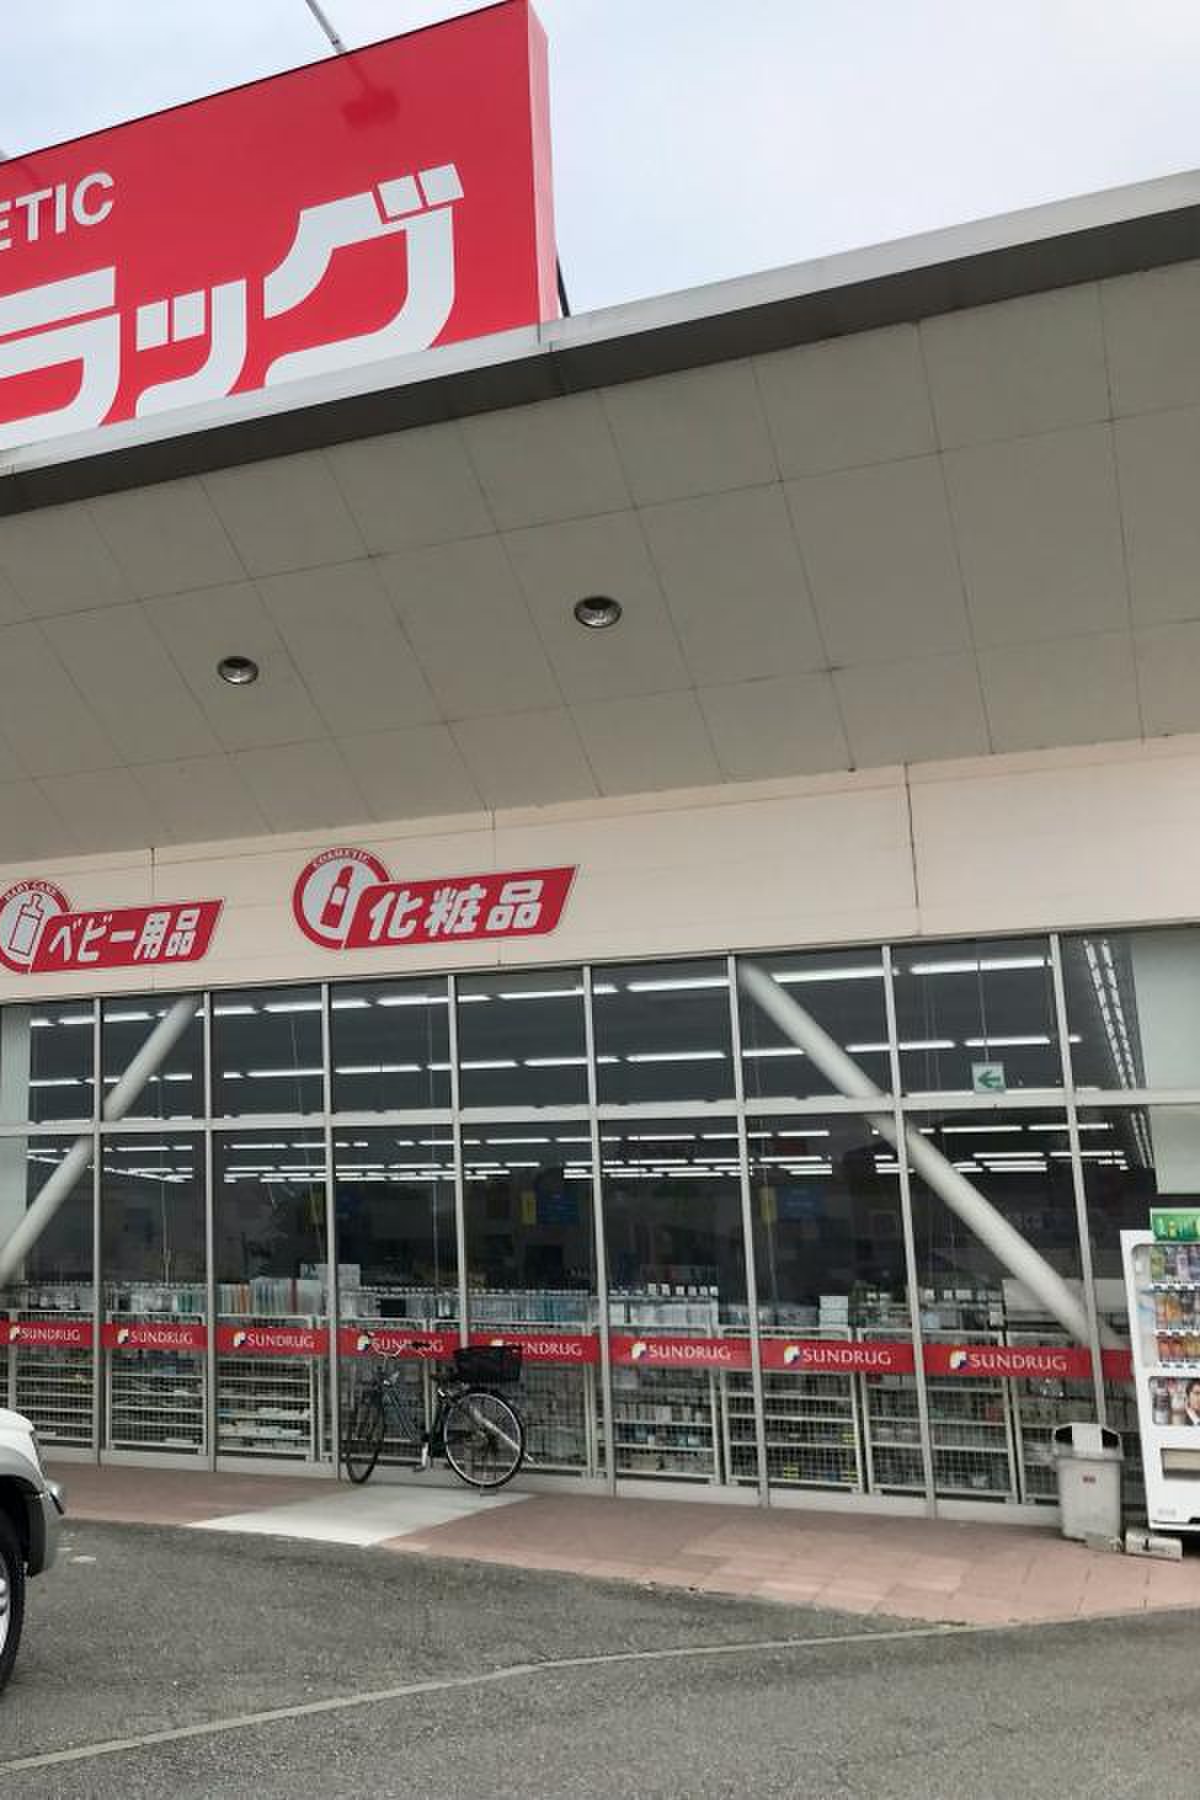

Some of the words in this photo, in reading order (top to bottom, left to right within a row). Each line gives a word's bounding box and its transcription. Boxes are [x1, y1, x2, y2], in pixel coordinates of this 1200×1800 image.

[369, 880, 545, 942] 化粧品
[47, 908, 200, 962] ベビー用品
[21, 1327, 81, 1341] SUNDRUG
[130, 1328, 193, 1345] SUNDRUG
[247, 1331, 315, 1349] SUNDRUG
[648, 1344, 732, 1361] SUNDRUG
[802, 1347, 892, 1366] SUNDRUG
[968, 1352, 1068, 1372] SUNDRUG
